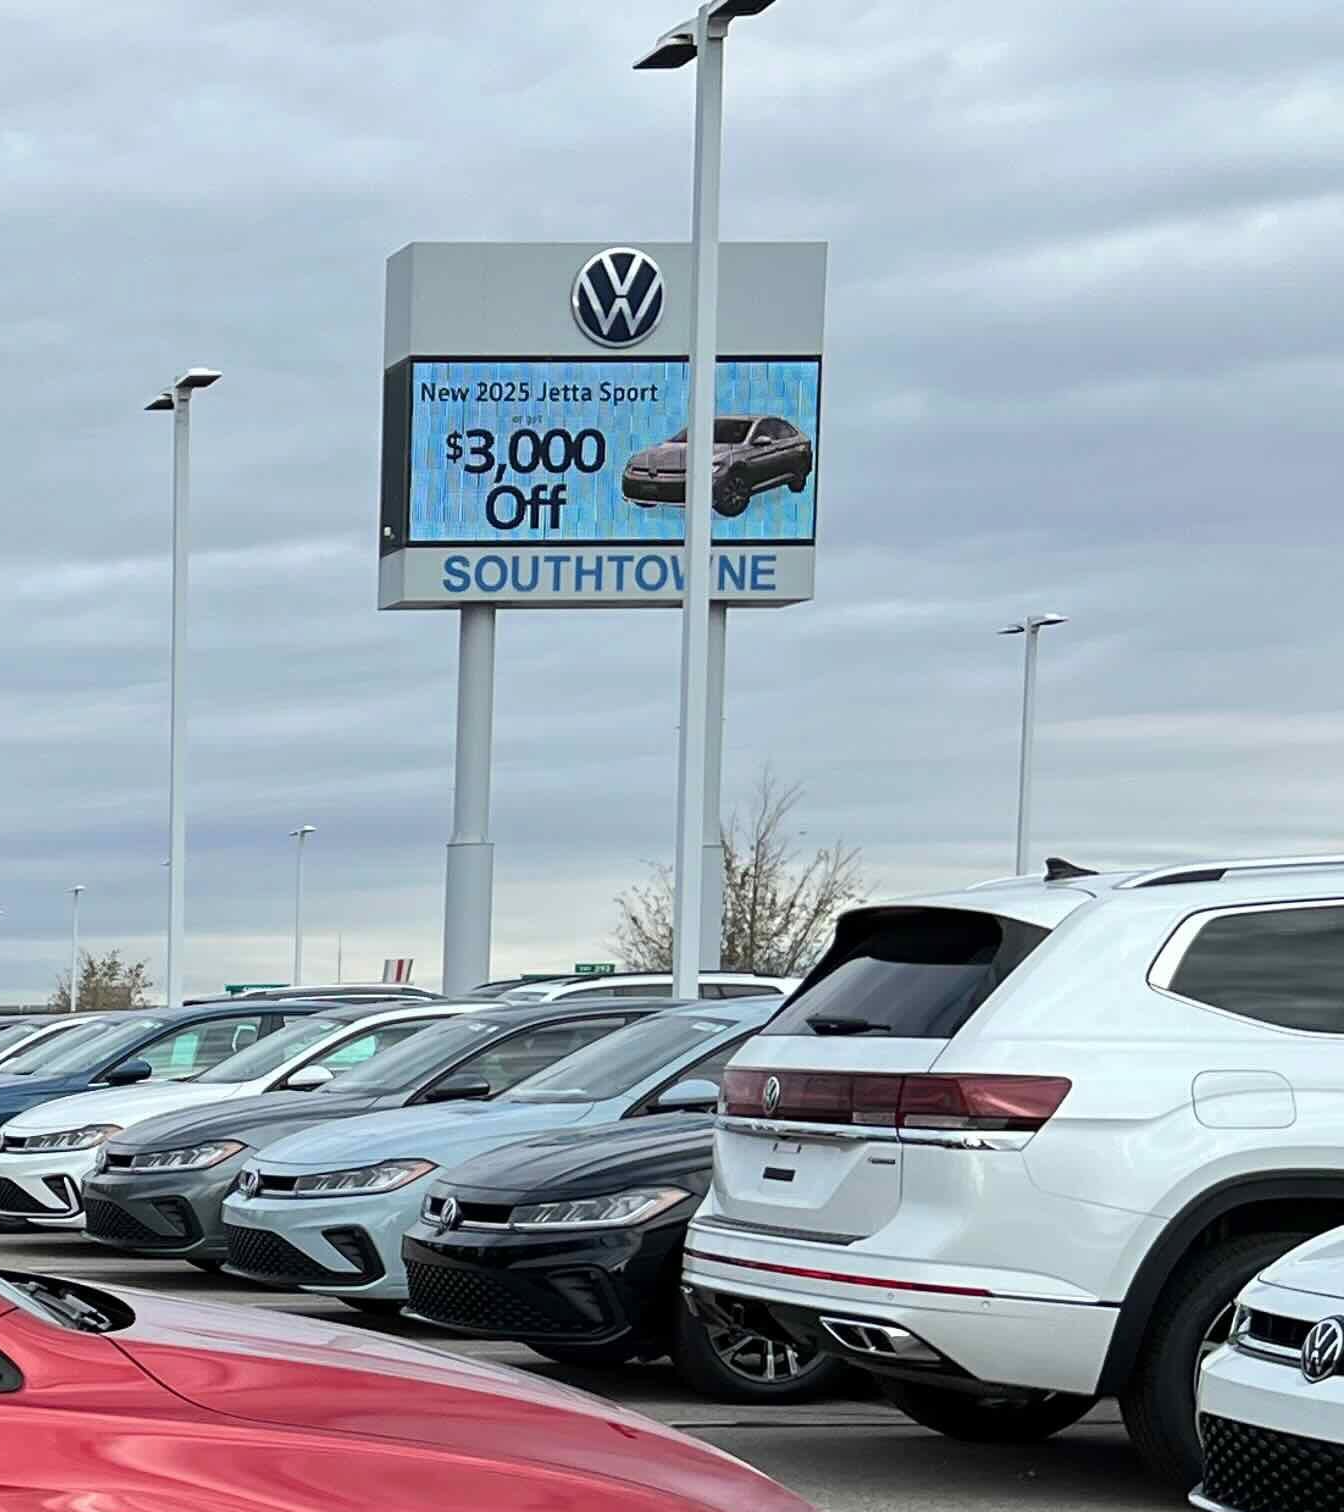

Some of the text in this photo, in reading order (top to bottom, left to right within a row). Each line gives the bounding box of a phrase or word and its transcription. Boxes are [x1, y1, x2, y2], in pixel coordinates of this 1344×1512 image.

[573, 247, 664, 347] VW
[420, 382, 659, 406] New 2025 Jetta Sport
[446, 428, 607, 483] $3,000
[485, 484, 567, 530] Off
